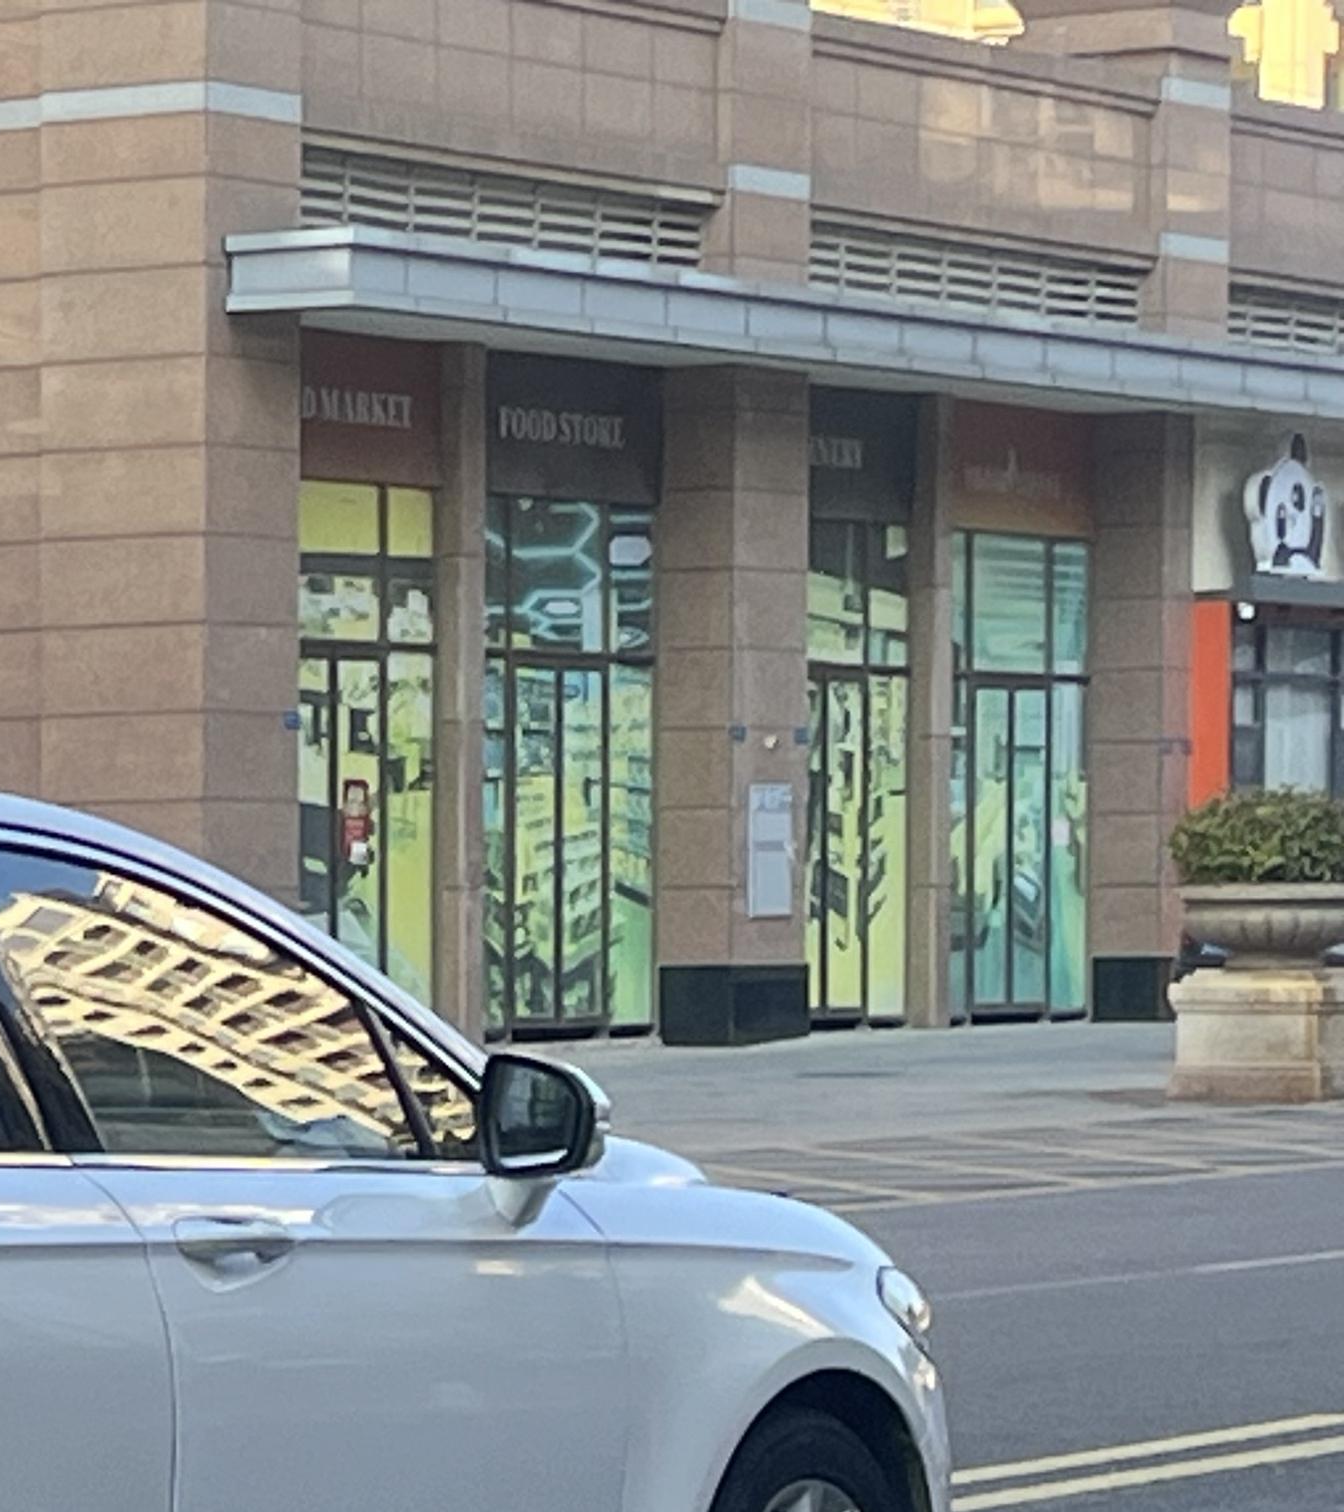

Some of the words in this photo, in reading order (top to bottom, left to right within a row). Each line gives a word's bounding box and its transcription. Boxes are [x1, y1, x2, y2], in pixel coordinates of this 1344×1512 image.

[320, 387, 413, 429] MARKET
[498, 405, 557, 442] FOOD
[559, 411, 626, 450] STORE
